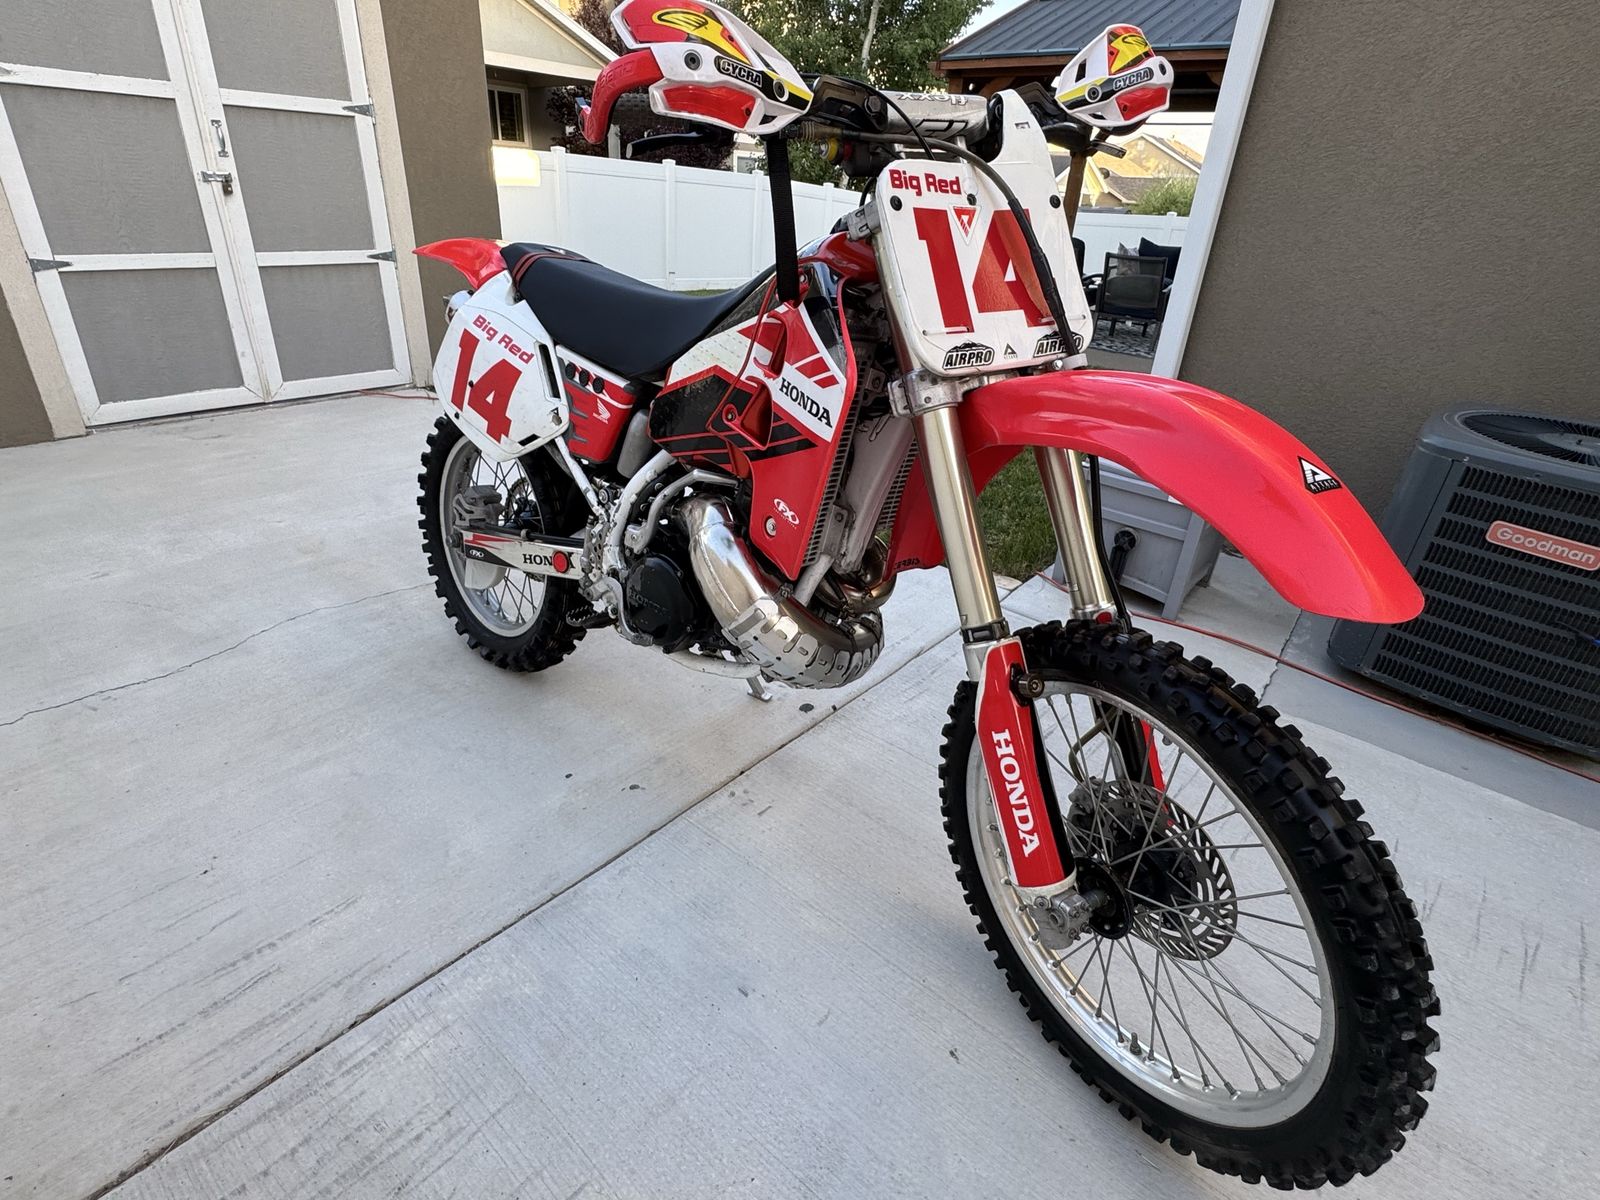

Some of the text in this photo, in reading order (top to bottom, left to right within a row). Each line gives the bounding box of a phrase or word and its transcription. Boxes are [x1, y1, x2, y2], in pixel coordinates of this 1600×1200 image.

[719, 57, 763, 87] CYCRA
[1112, 67, 1151, 91] CYCRA
[888, 168, 962, 197] Big Red
[912, 206, 1058, 335] 14
[472, 314, 535, 365] Big Red
[944, 349, 993, 369] AIRPRO
[450, 328, 523, 445] 14
[778, 377, 834, 430] HONDA
[1495, 525, 1597, 566] Goodman
[992, 729, 1040, 857] HONDA
